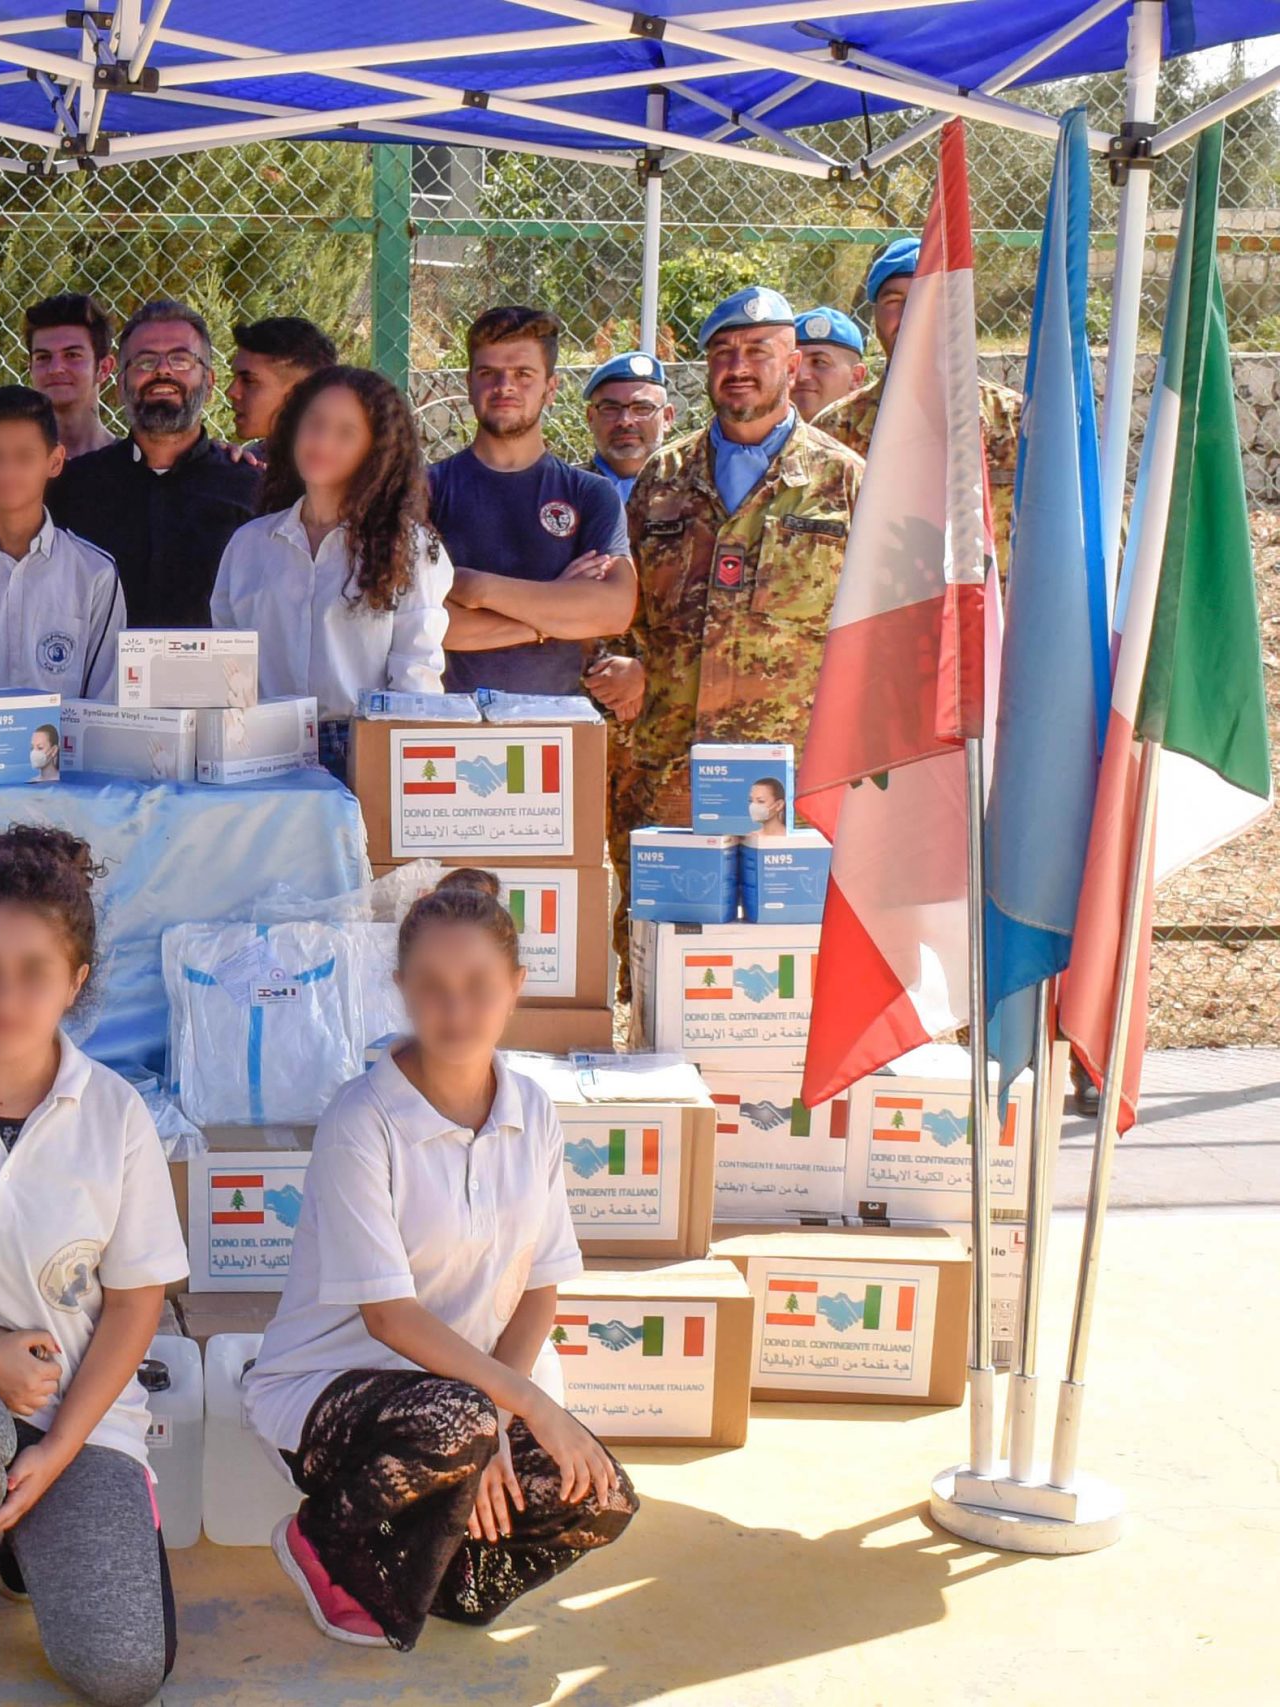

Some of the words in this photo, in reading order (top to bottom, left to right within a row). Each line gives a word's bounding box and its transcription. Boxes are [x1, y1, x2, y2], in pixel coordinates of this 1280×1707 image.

[128, 667, 138, 680] L
[121, 711, 140, 721] Vinyl
[64, 736, 73, 749] L
[698, 765, 728, 775] KN95
[403, 809, 431, 818] DONO
[433, 808, 450, 817] DEL
[452, 808, 517, 817] CONTINGENTE
[519, 807, 560, 816] ITALIANO
[489, 827, 506, 839] من
[637, 852, 664, 862] KN95
[763, 854, 793, 864] KN95
[519, 946, 557, 955] TALIANO
[684, 1012, 709, 1021] DONO
[710, 1012, 727, 1021] DEL
[729, 1012, 786, 1021] CONTINGENTE
[788, 1011, 809, 1020] ITALI
[871, 1153, 896, 1162] DONO
[897, 1154, 913, 1163] DEL
[718, 1160, 774, 1170] CONTINGENTE
[775, 1163, 810, 1172] MILITARE
[566, 1188, 617, 1197] NTINGENTE
[619, 1188, 659, 1197] ITALIANO
[211, 1238, 239, 1248] DONO
[241, 1238, 258, 1248] DEL
[260, 1238, 294, 1248] CONTIN
[260, 1254, 290, 1269] لكتيبة
[764, 1338, 789, 1347] DONO
[791, 1339, 808, 1348] DEL
[810, 1341, 870, 1351] CONTINGENTE
[872, 1343, 911, 1352] ITALIANO
[568, 1382, 625, 1390] CONTINGENTE
[627, 1383, 665, 1391] MILITARE
[666, 1383, 705, 1391] ITALIANO
